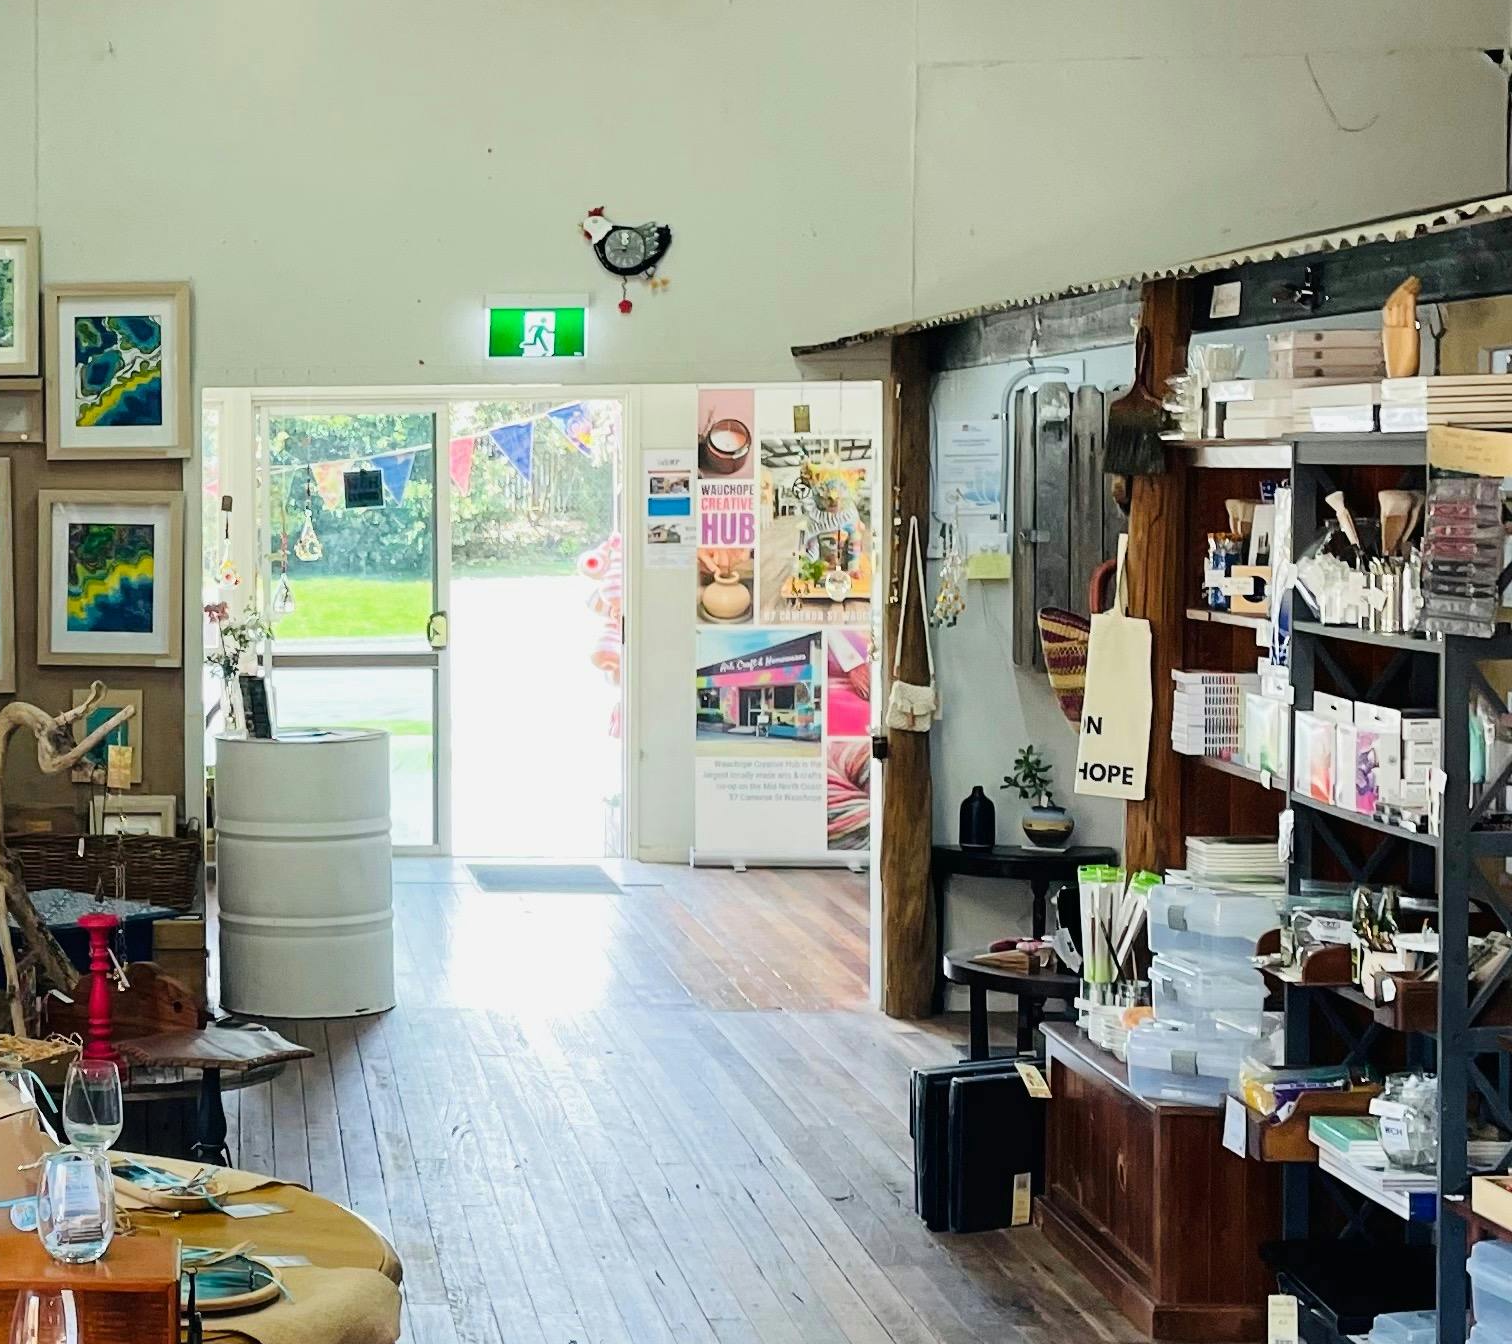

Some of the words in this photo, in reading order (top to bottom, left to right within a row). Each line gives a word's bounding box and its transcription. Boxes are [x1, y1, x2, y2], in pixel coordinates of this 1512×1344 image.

[701, 484, 754, 495] WAUCHOPE
[701, 497, 754, 511] CREATIVE
[701, 513, 755, 544] HUB
[1084, 716, 1102, 735] N
